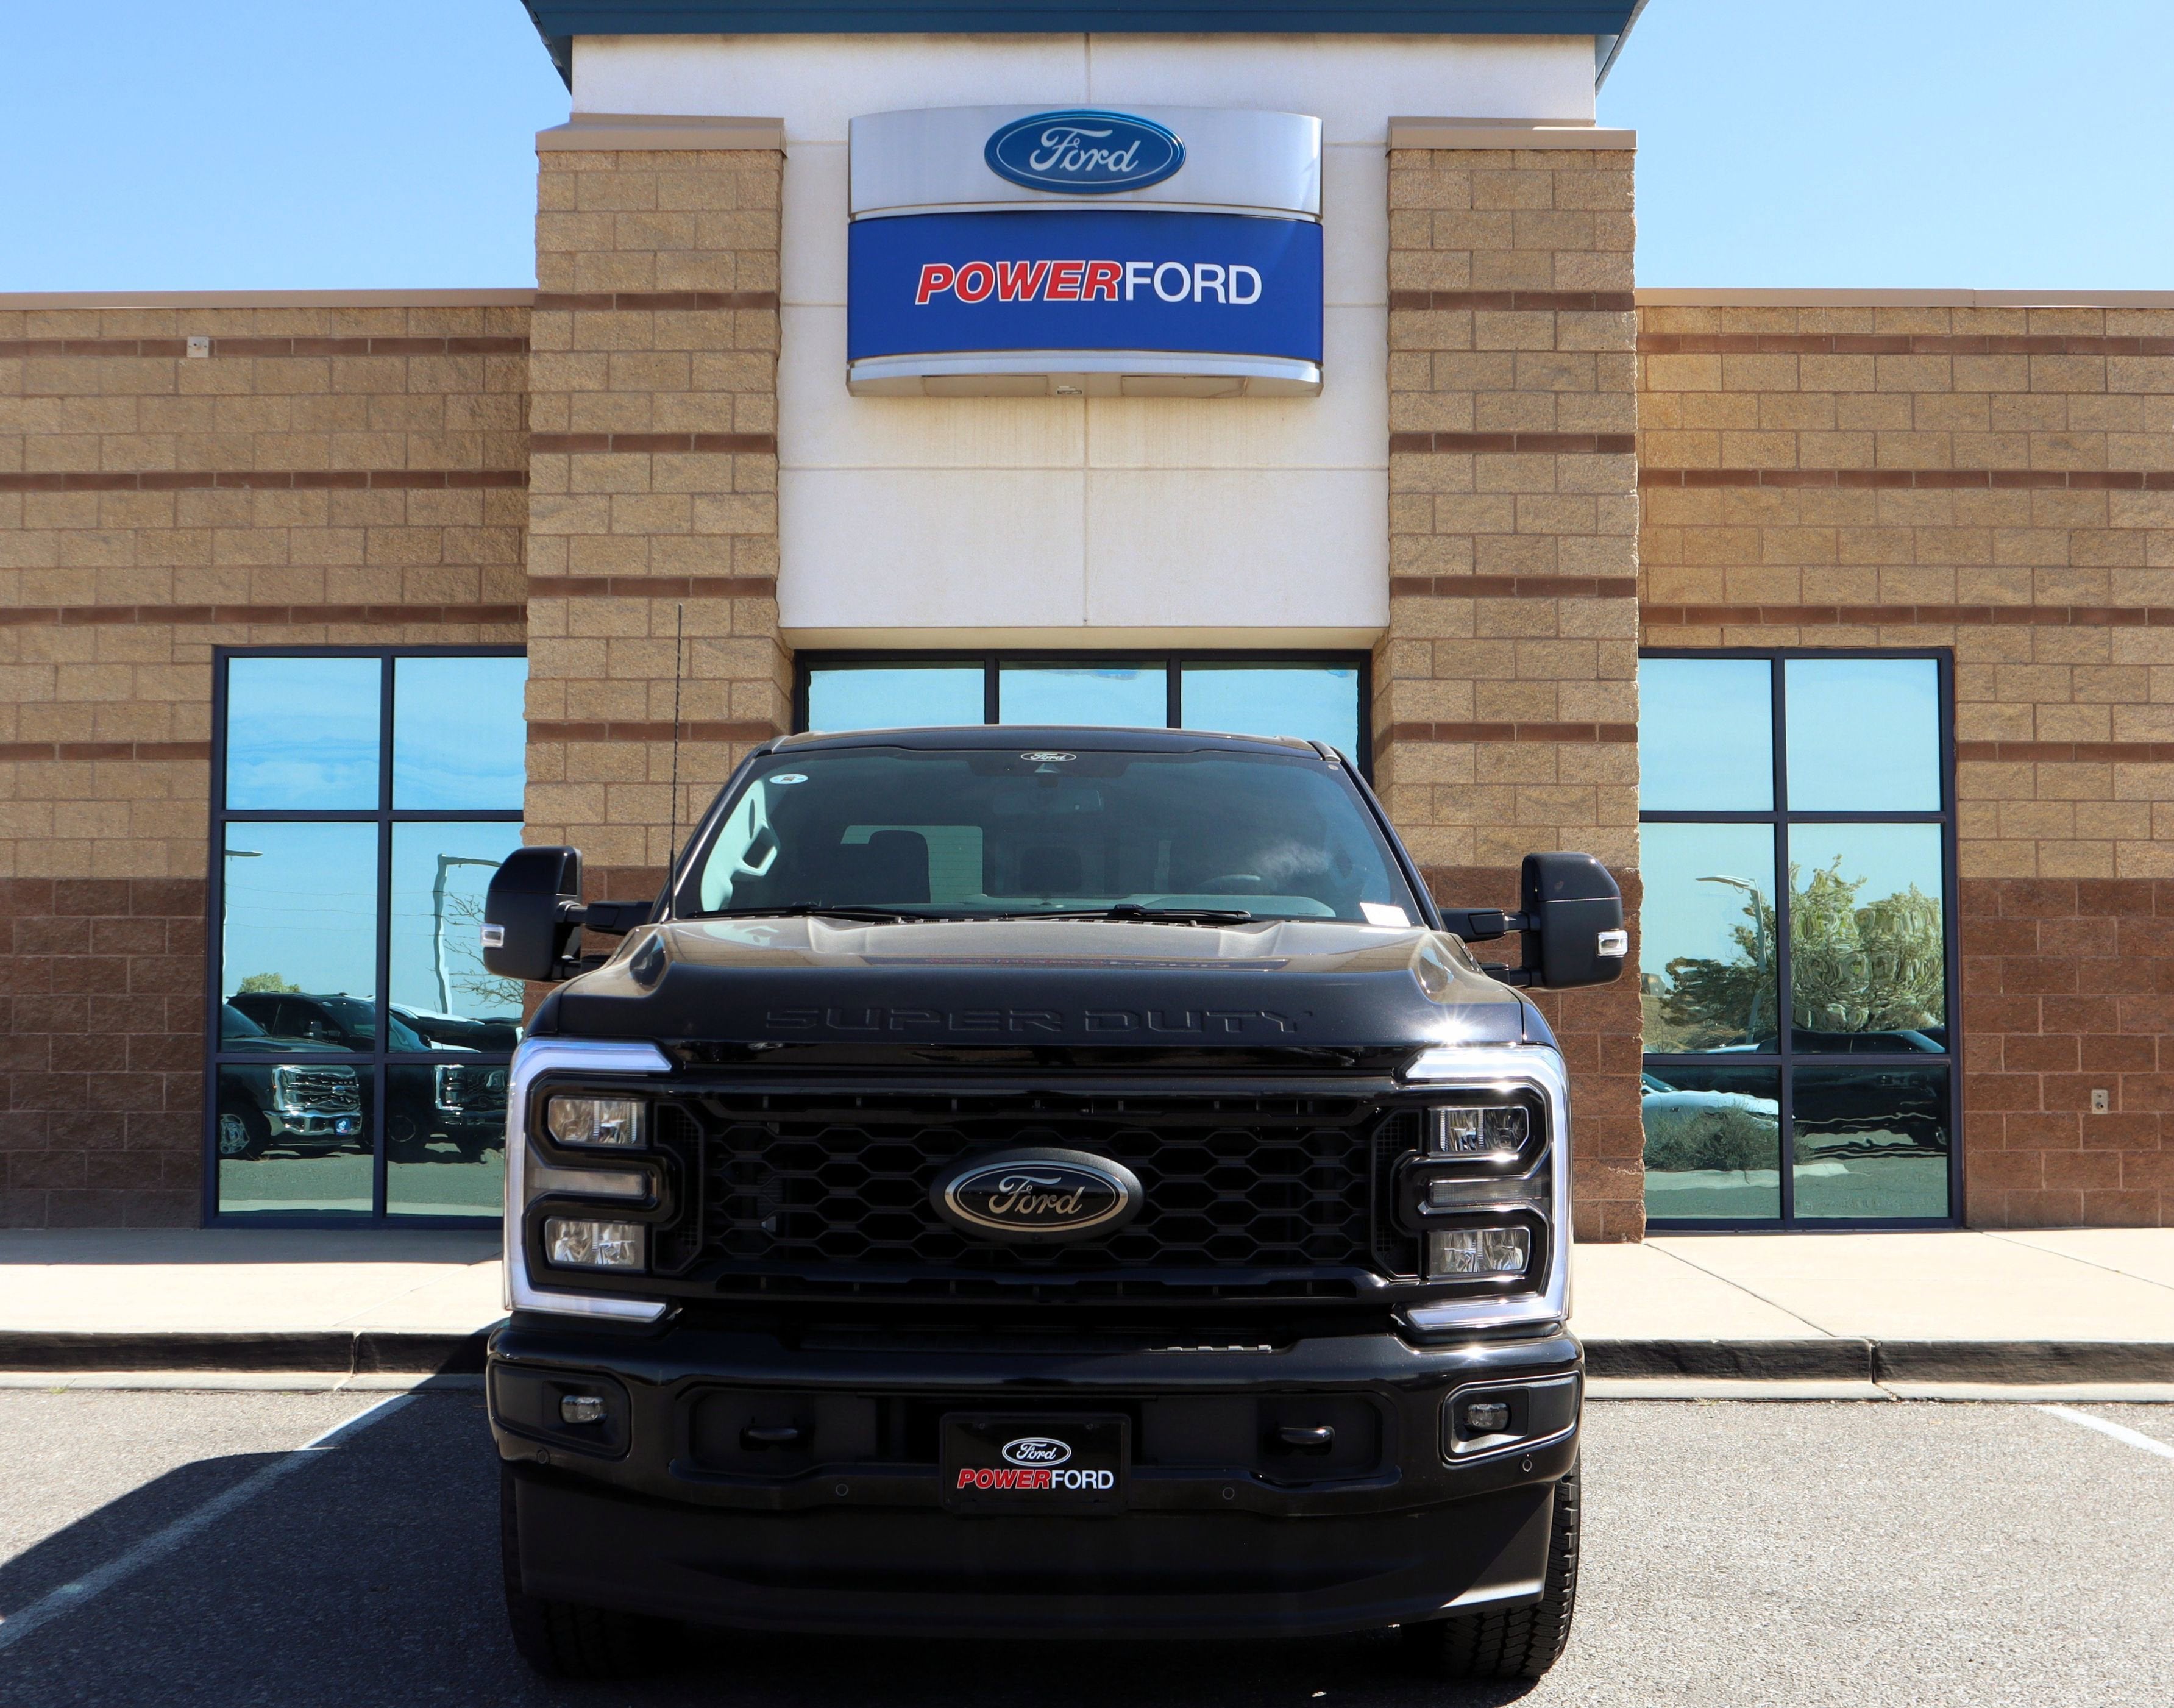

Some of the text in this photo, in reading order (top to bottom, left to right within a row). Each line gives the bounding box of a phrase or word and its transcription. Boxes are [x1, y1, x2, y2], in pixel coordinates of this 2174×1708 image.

[1030, 127, 1140, 172] Ford
[766, 1008, 1313, 1032] SUPER DUTY
[989, 1175, 1085, 1214] Ford
[1016, 1442, 1057, 1460] Ford
